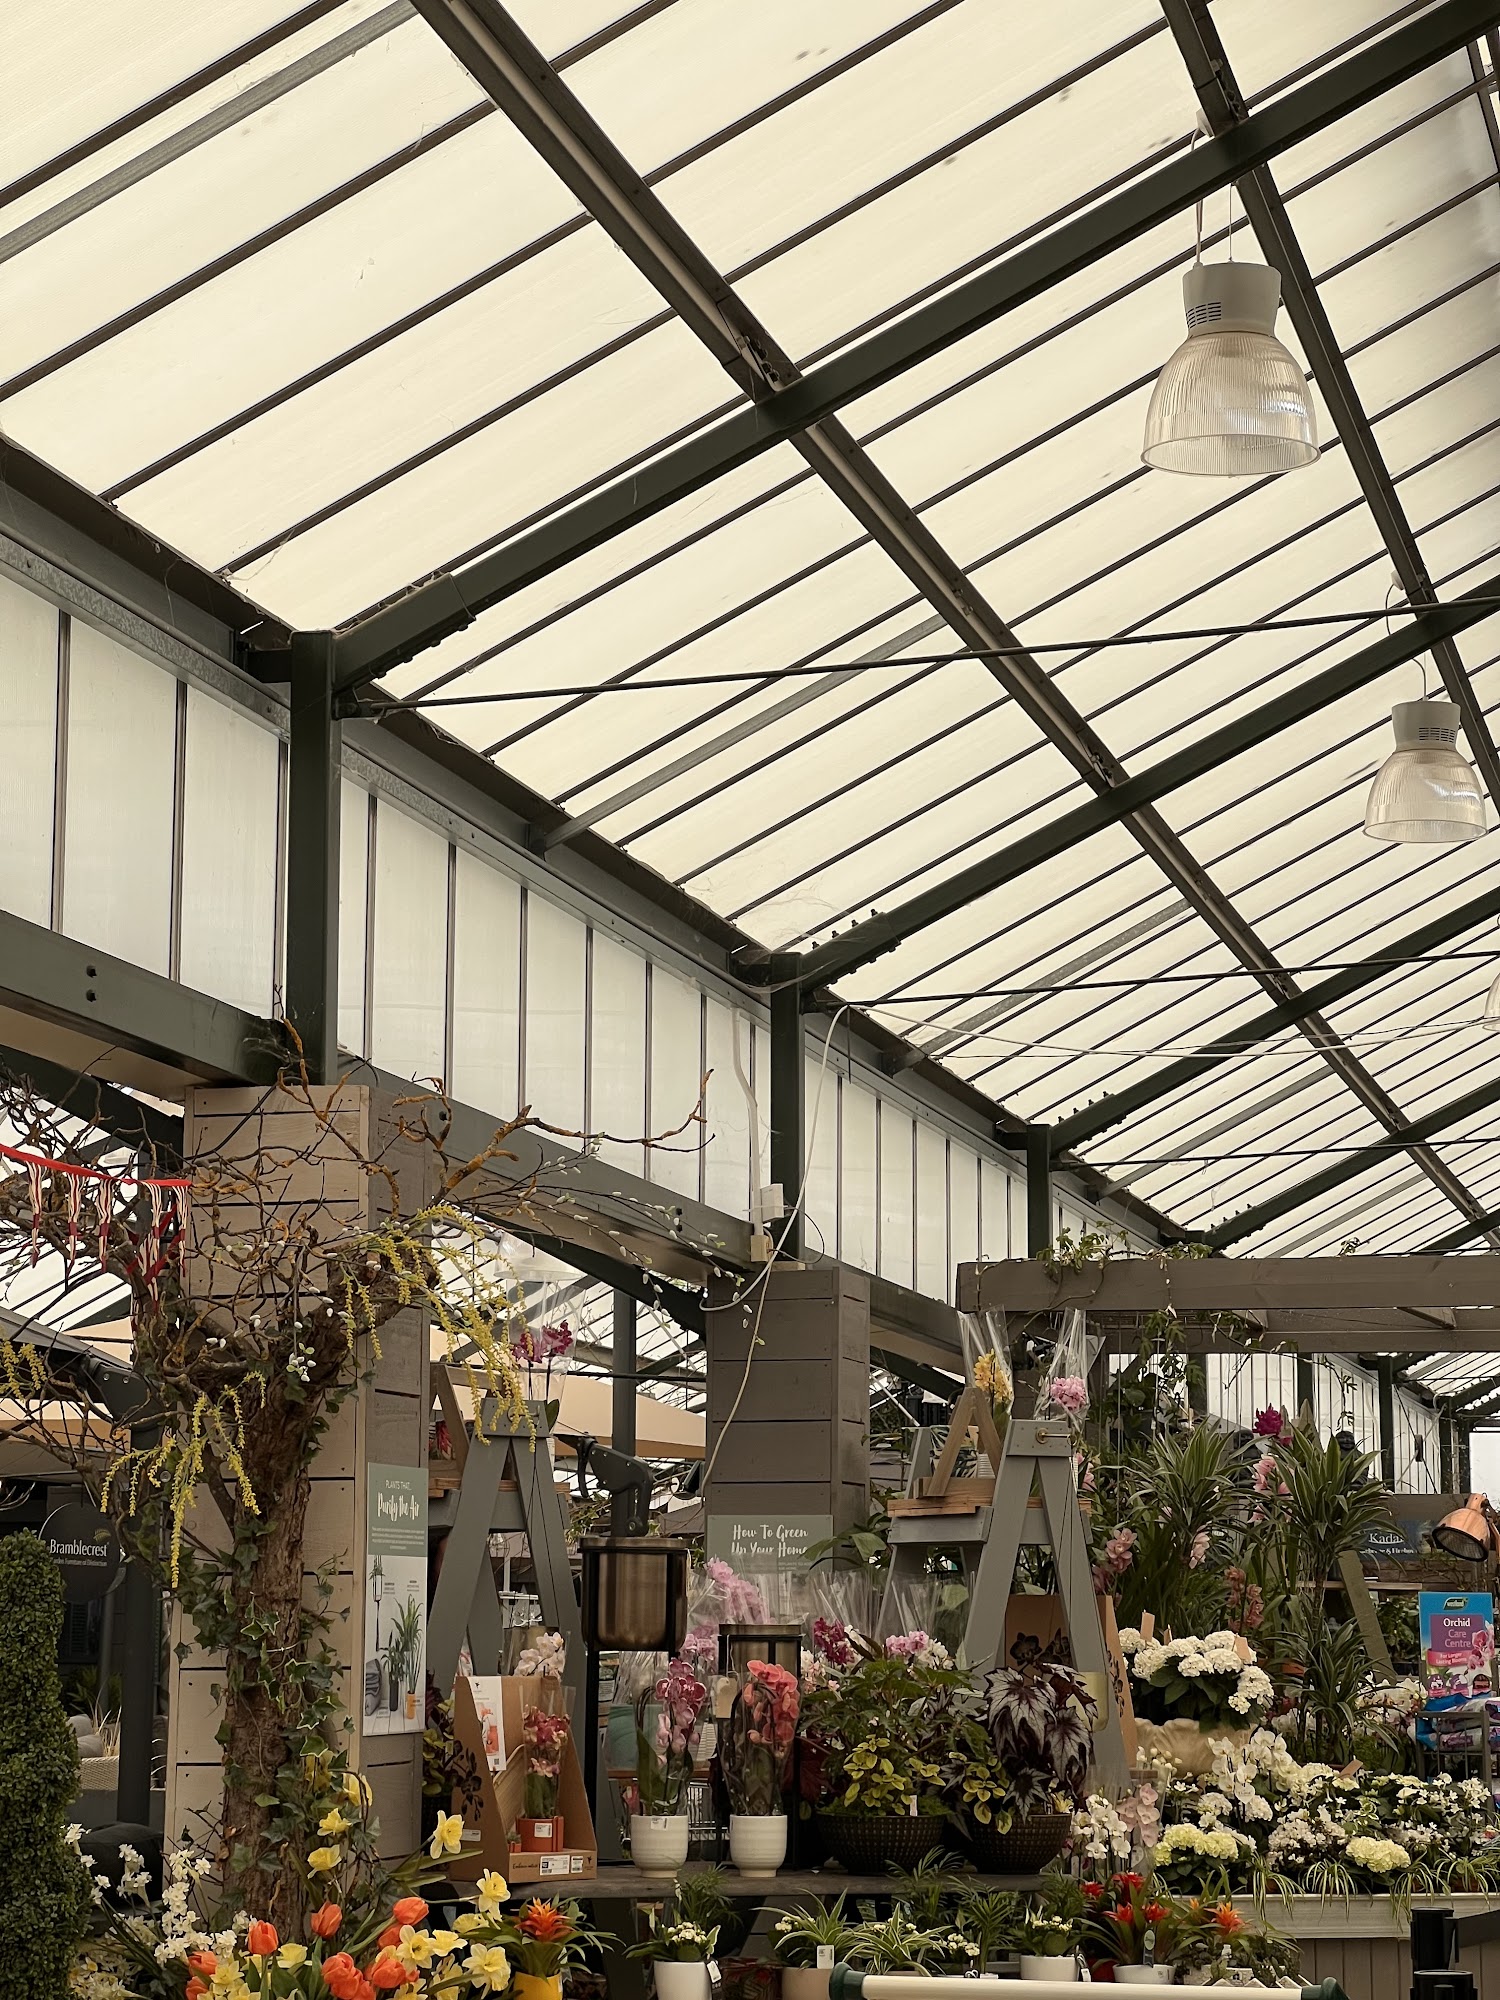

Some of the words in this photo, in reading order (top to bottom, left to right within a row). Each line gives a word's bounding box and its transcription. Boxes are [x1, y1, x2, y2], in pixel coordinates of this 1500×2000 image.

[385, 1479, 400, 1490] PLANTS
[377, 1491, 398, 1522] Purify
[409, 1494, 420, 1521] Air
[733, 1524, 757, 1540] How
[760, 1524, 773, 1540] To
[776, 1524, 808, 1542] Green
[49, 1538, 107, 1557] Bramblecrest
[750, 1541, 774, 1557] Your
[1443, 1617, 1471, 1627] Orchid
[1448, 1629, 1467, 1638] Care
[1444, 1639, 1471, 1648] Centre
